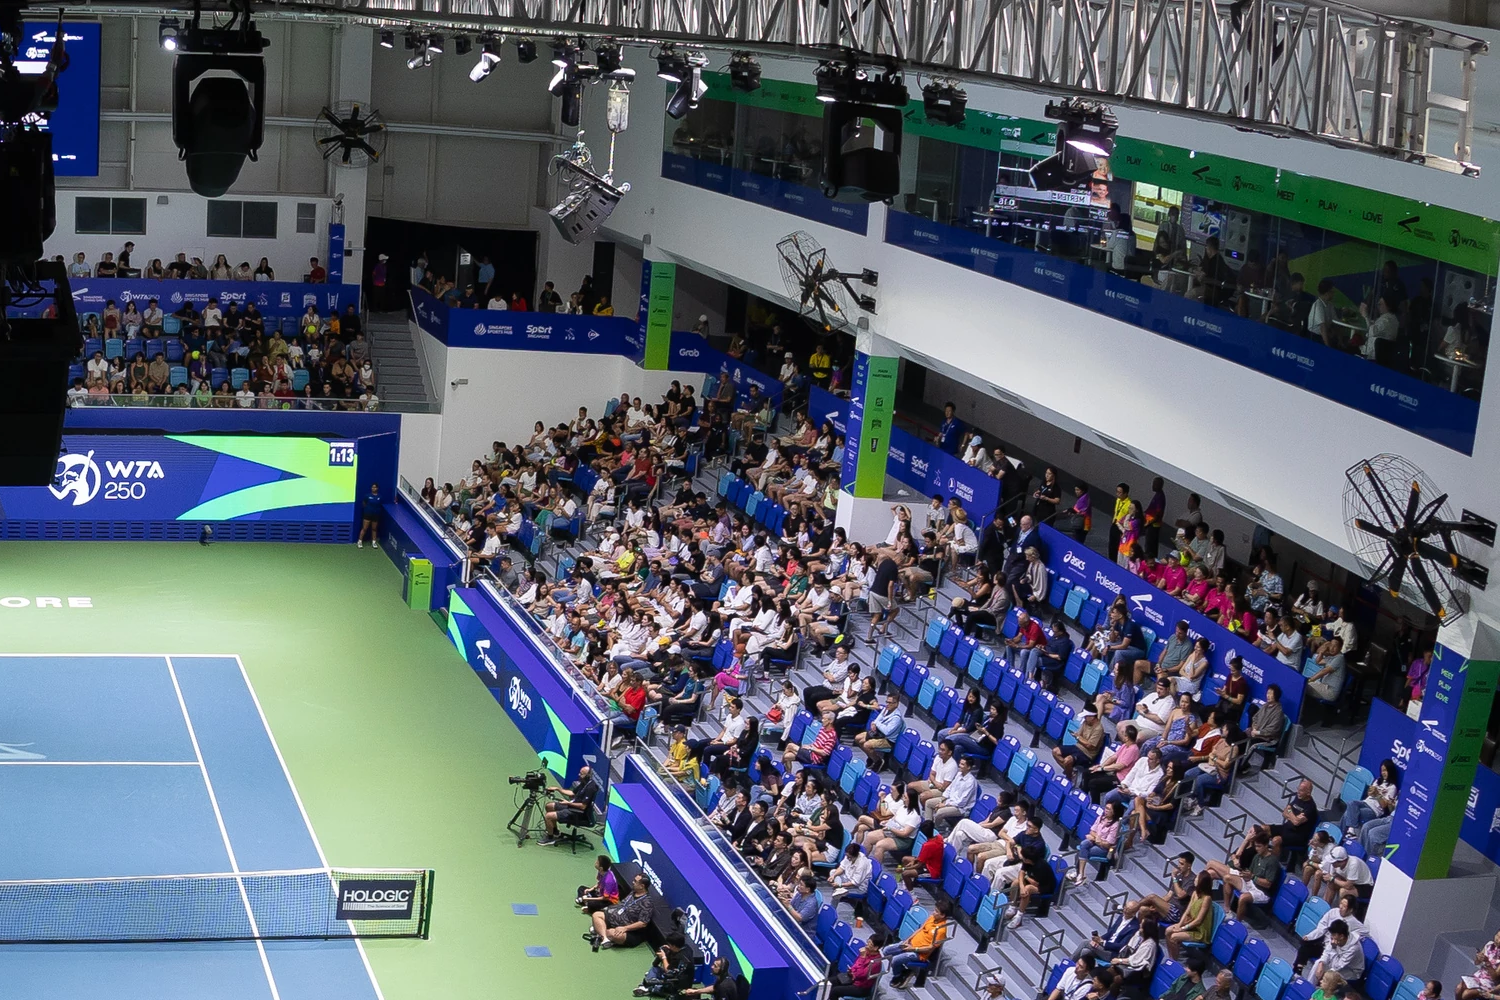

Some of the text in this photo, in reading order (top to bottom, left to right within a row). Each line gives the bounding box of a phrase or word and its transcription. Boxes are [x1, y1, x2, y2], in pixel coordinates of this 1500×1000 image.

[1126, 155, 1177, 174] PLAY LOVE
[1276, 190, 1384, 224] MEET PLAY LOVE
[220, 291, 246, 302] Sport
[526, 324, 553, 334] Sport
[679, 348, 700, 357] Grab
[1399, 393, 1419, 407] WORLD
[330, 448, 354, 463] 1:13
[106, 460, 164, 479] WTA
[104, 482, 146, 499] 250
[1070, 554, 1087, 570] asics
[1095, 571, 1123, 595] Polestar
[1440, 668, 1453, 680] MEET
[1438, 679, 1451, 692] PLAY
[1435, 691, 1450, 704] LOVE
[343, 890, 411, 902] HOLOGIC
[702, 924, 718, 957] WTA
